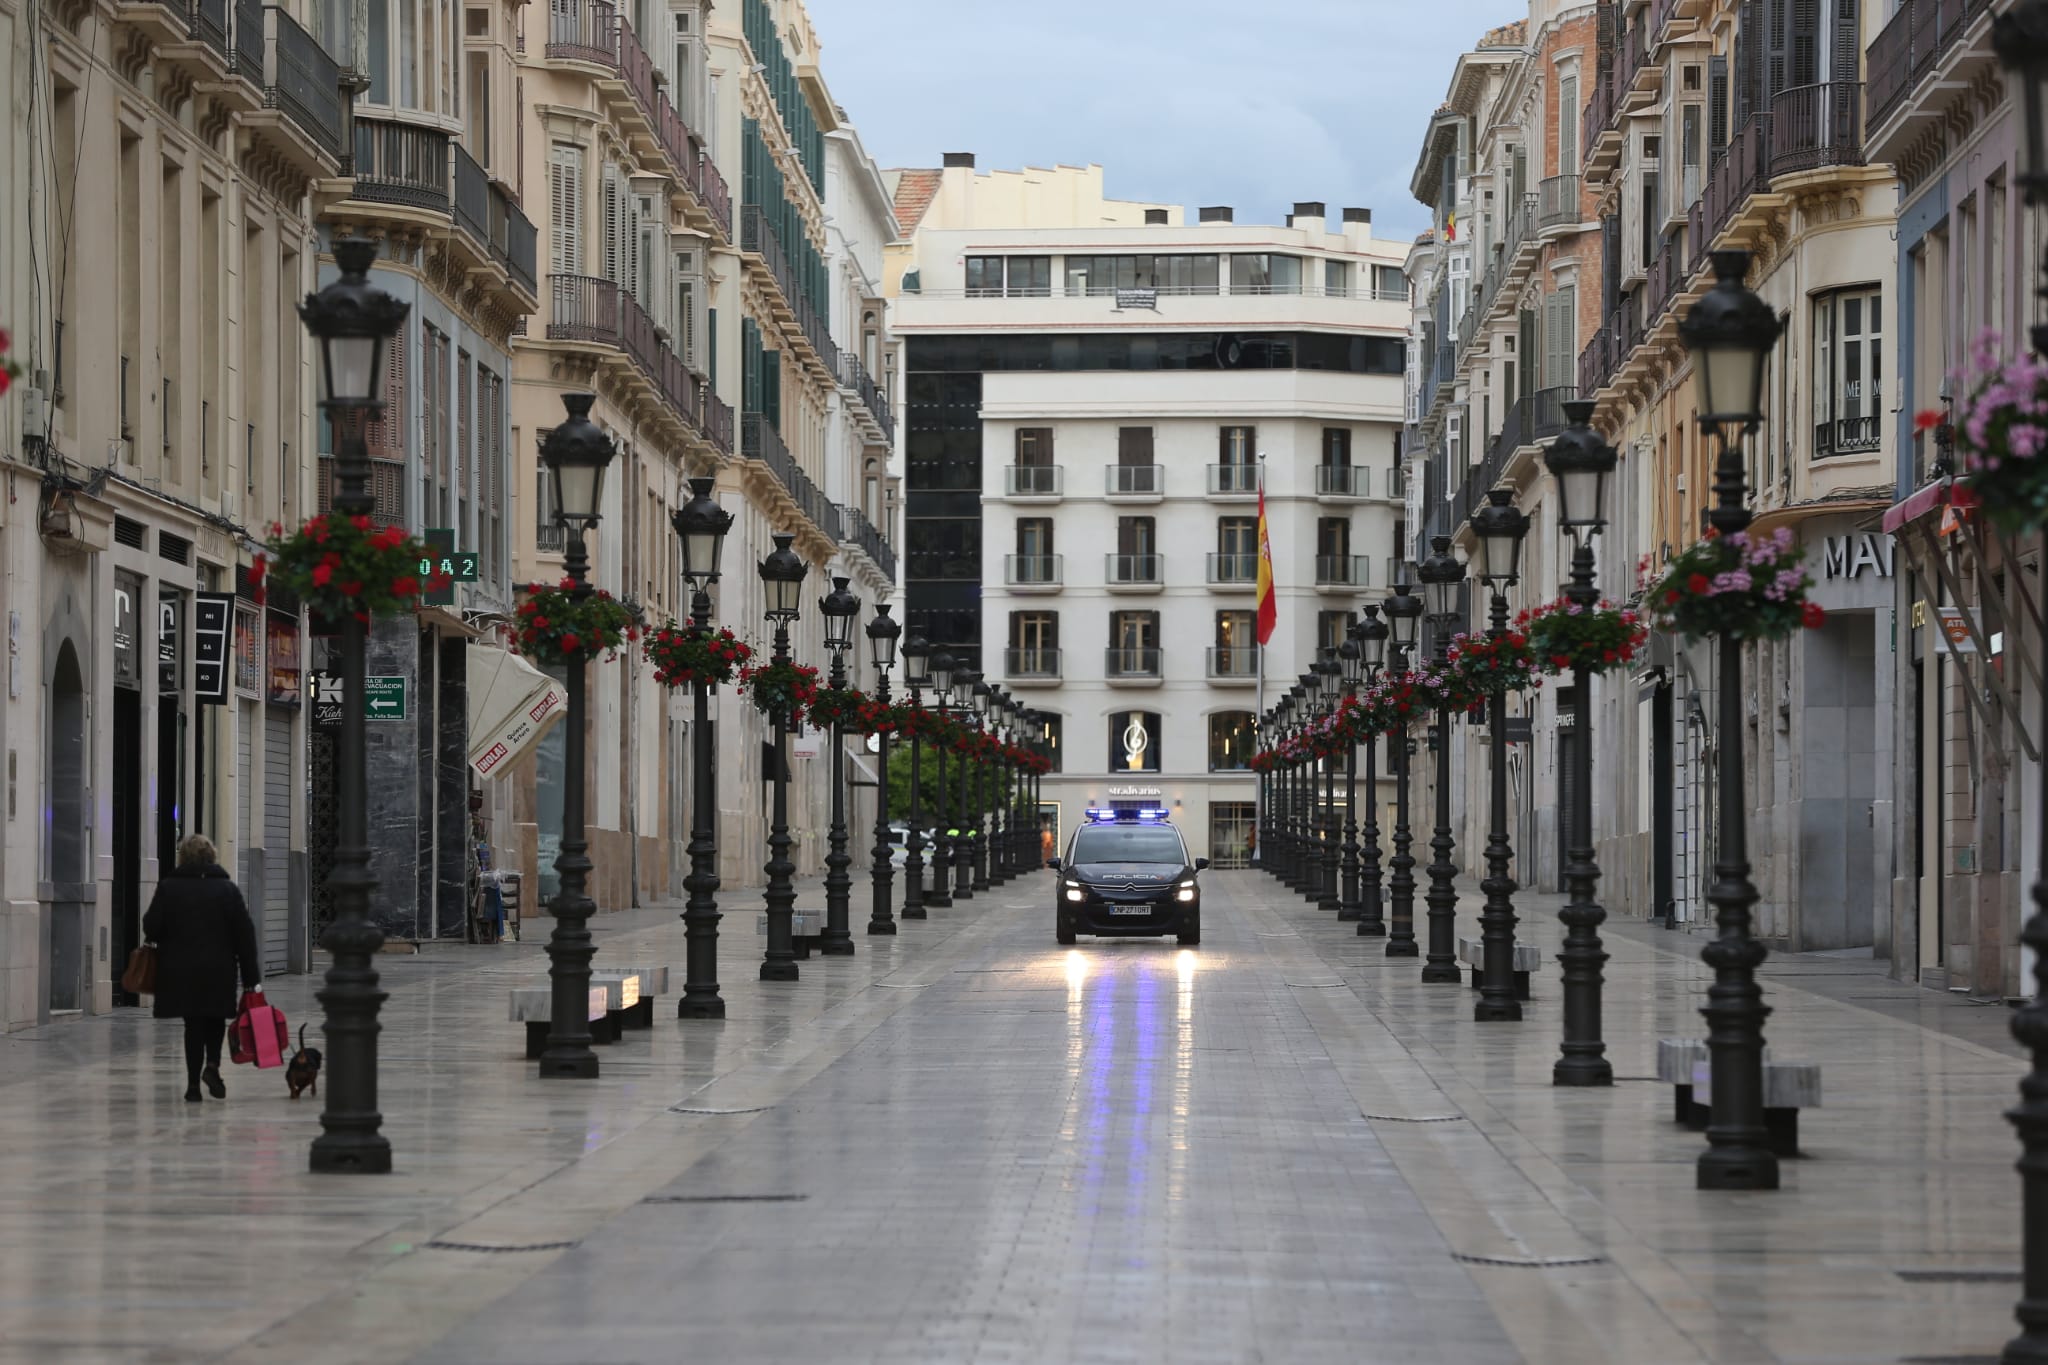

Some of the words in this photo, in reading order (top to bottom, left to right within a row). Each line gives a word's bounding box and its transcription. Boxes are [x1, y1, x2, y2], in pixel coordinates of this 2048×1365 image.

[531, 691, 558, 722] ¡HOLA!
[513, 727, 530, 744] Arturo
[476, 743, 507, 773] ¡HOLA!
